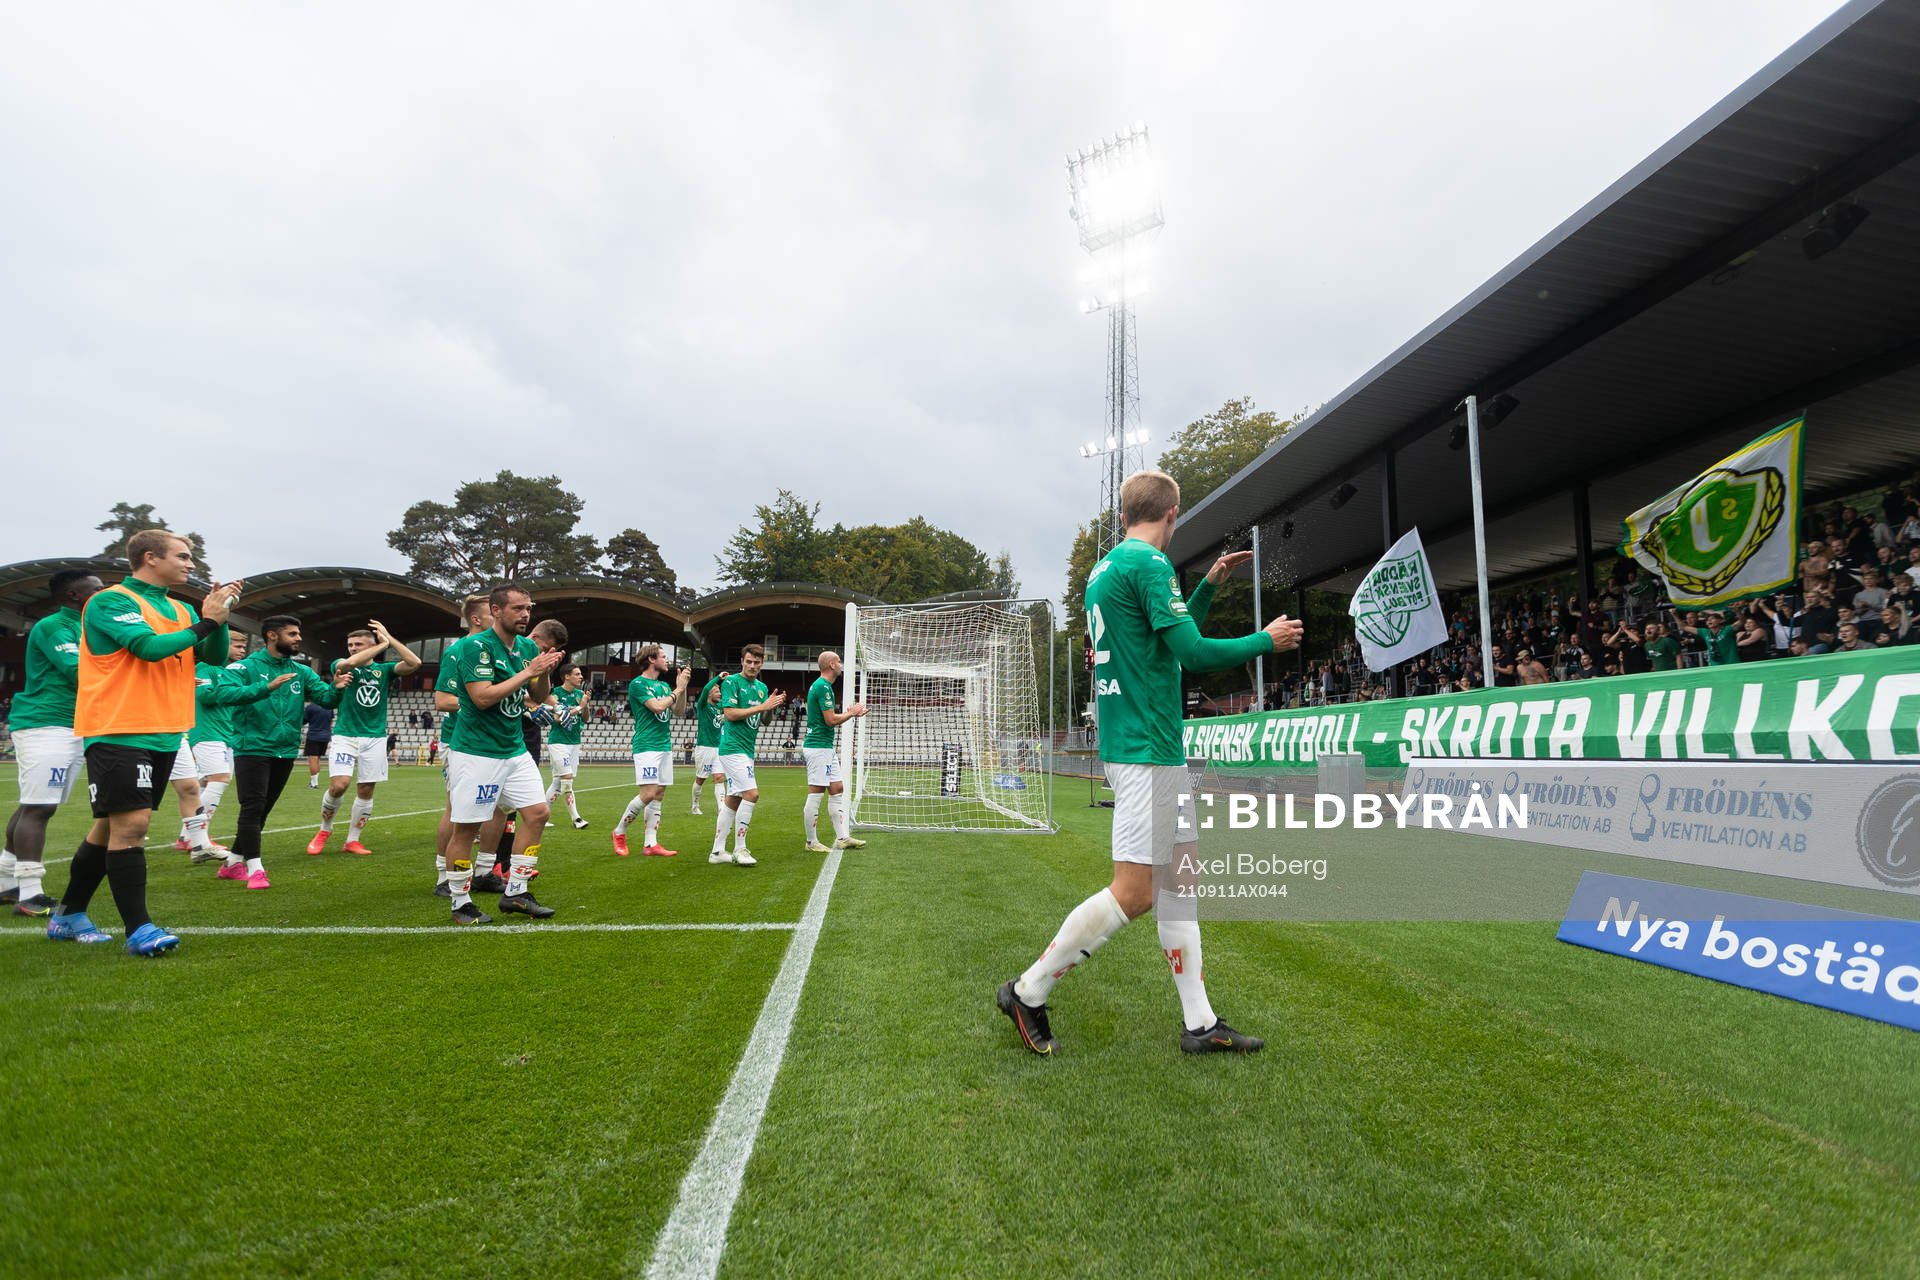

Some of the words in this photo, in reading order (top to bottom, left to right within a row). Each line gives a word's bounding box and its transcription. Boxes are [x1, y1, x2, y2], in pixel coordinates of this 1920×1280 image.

[1194, 722, 1259, 762] SVENSK
[1260, 713, 1363, 762] FOTBOLL
[1399, 697, 1592, 763] SKROTA
[476, 784, 499, 800] NP
[1425, 772, 1494, 799] FRÖDÉNS
[1523, 775, 1618, 809] FRÖDÉNS
[1665, 778, 1813, 822] FRÖDÉNS
[1526, 809, 1592, 831] ENTILATION
[1593, 818, 1612, 833] AB
[1662, 820, 1773, 849] VENTILATION
[1776, 832, 1808, 853] AB
[1596, 896, 1690, 953] Nya
